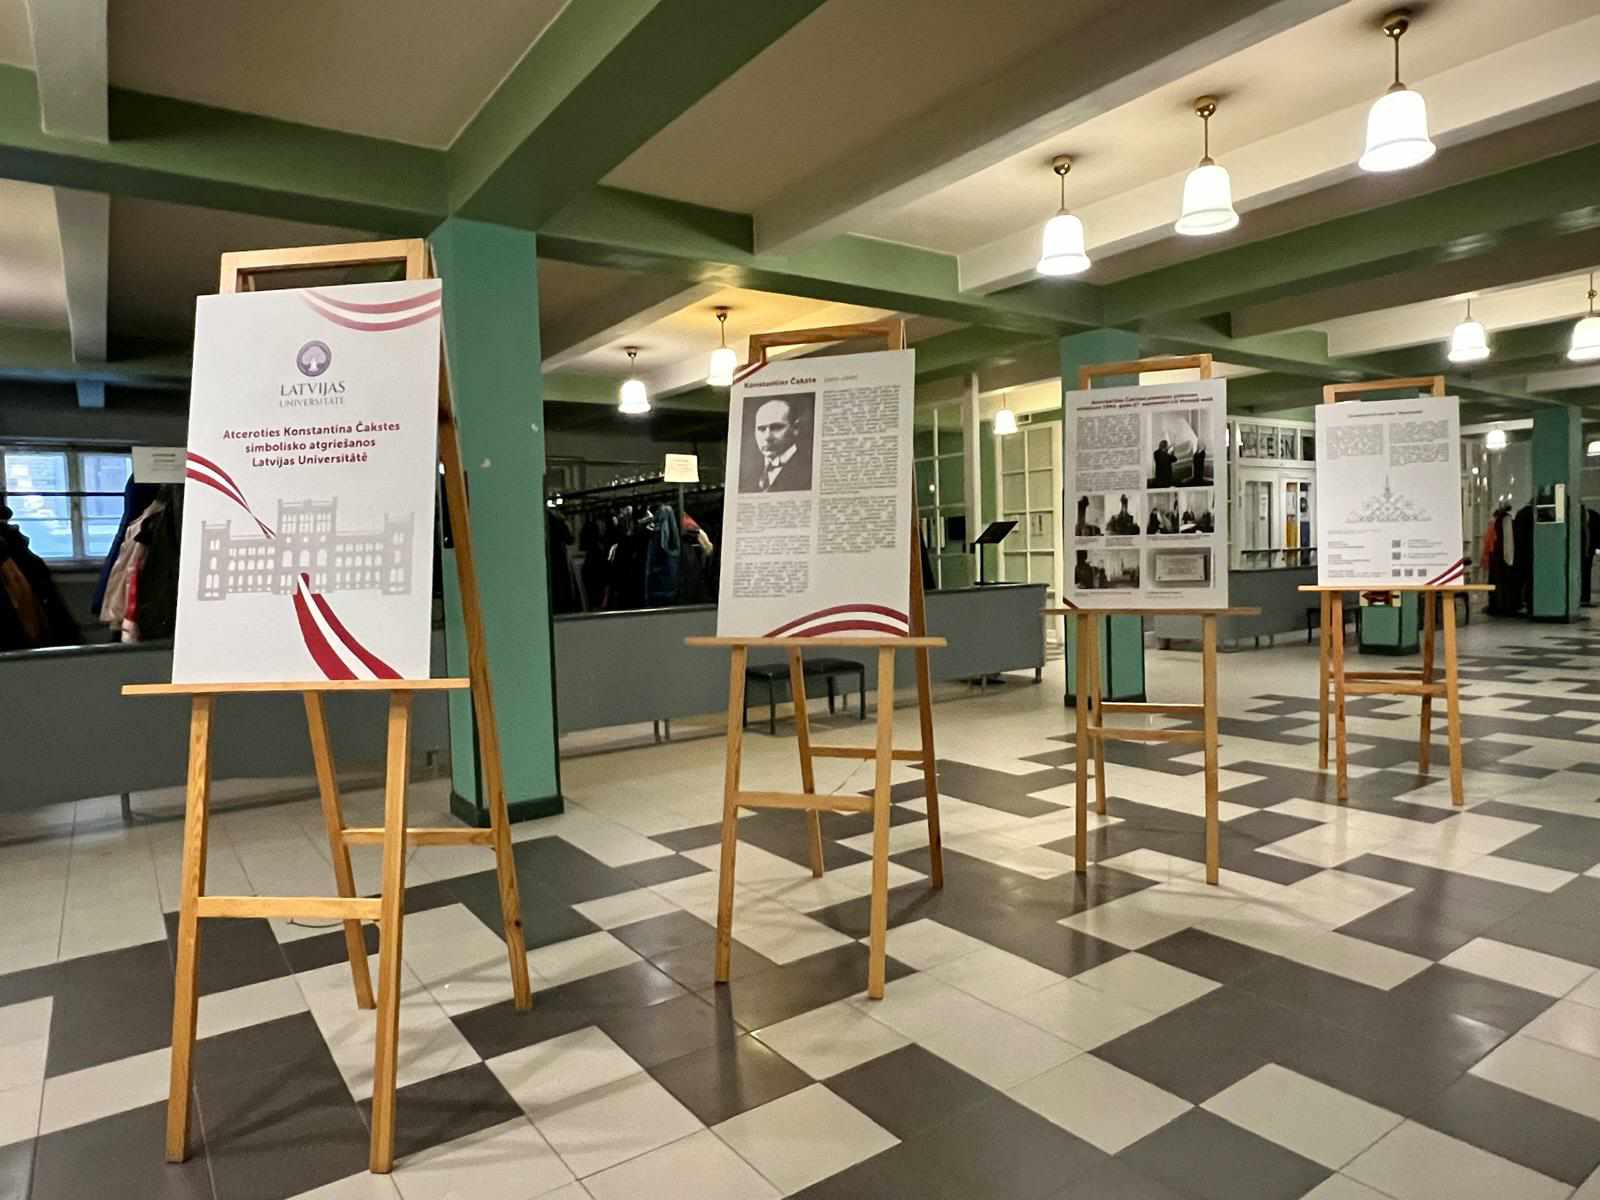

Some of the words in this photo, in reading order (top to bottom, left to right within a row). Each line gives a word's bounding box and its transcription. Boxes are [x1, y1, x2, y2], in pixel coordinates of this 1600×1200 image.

[280, 380, 346, 396] LATVIJAS
[223, 427, 281, 440] Atceroties
[355, 420, 401, 433] Čakstes
[245, 441, 307, 453] simbolisko
[309, 439, 376, 453] atgriešanos
[252, 455, 295, 468] Latvijas
